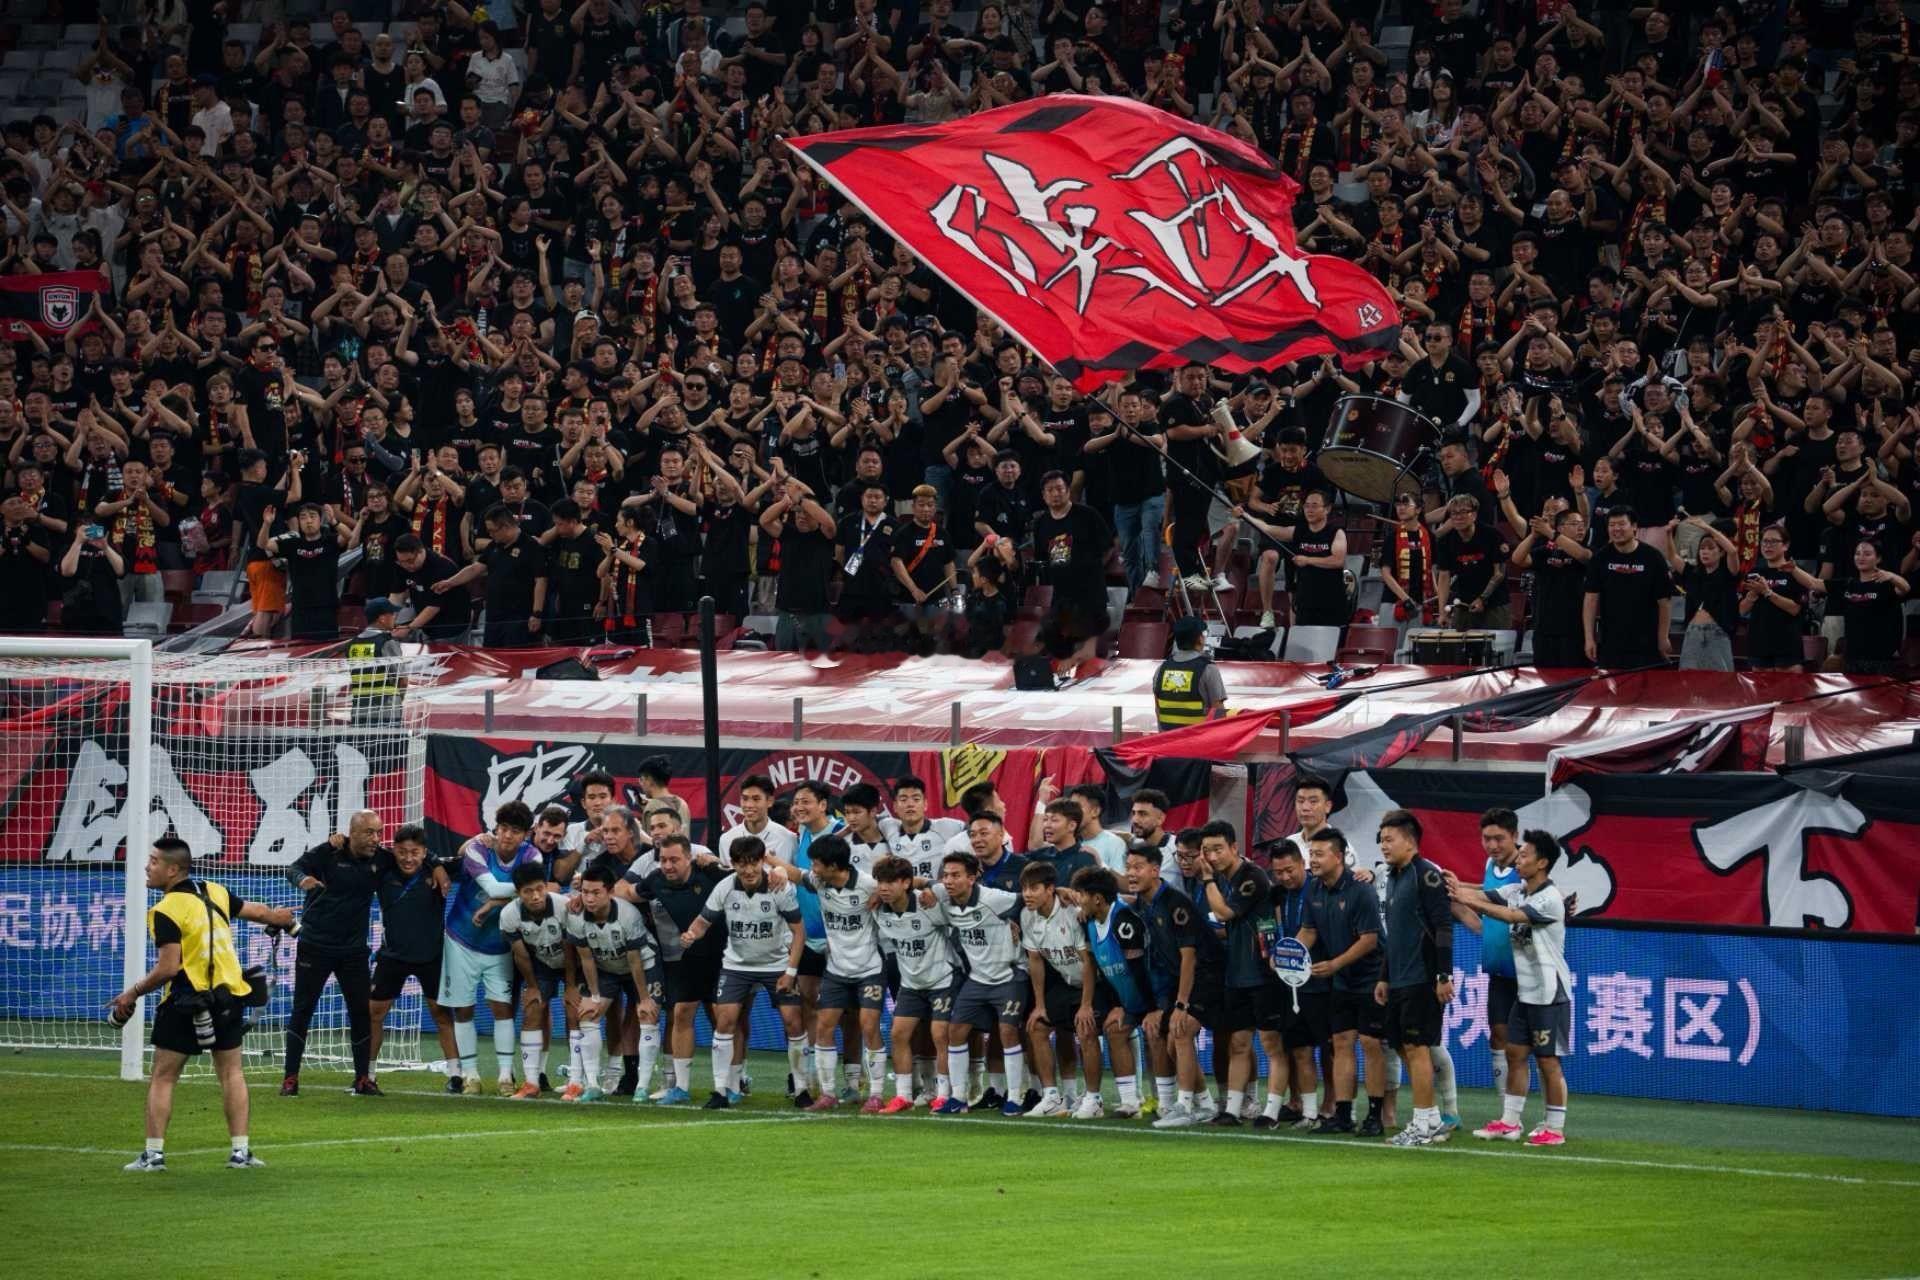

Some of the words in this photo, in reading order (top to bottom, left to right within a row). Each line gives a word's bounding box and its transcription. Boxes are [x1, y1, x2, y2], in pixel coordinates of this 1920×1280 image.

[767, 755, 862, 791] NEVER
[863, 984, 883, 1001] 23
[932, 996, 952, 1013] 21
[1442, 964, 1760, 1066] 陕赛区)
